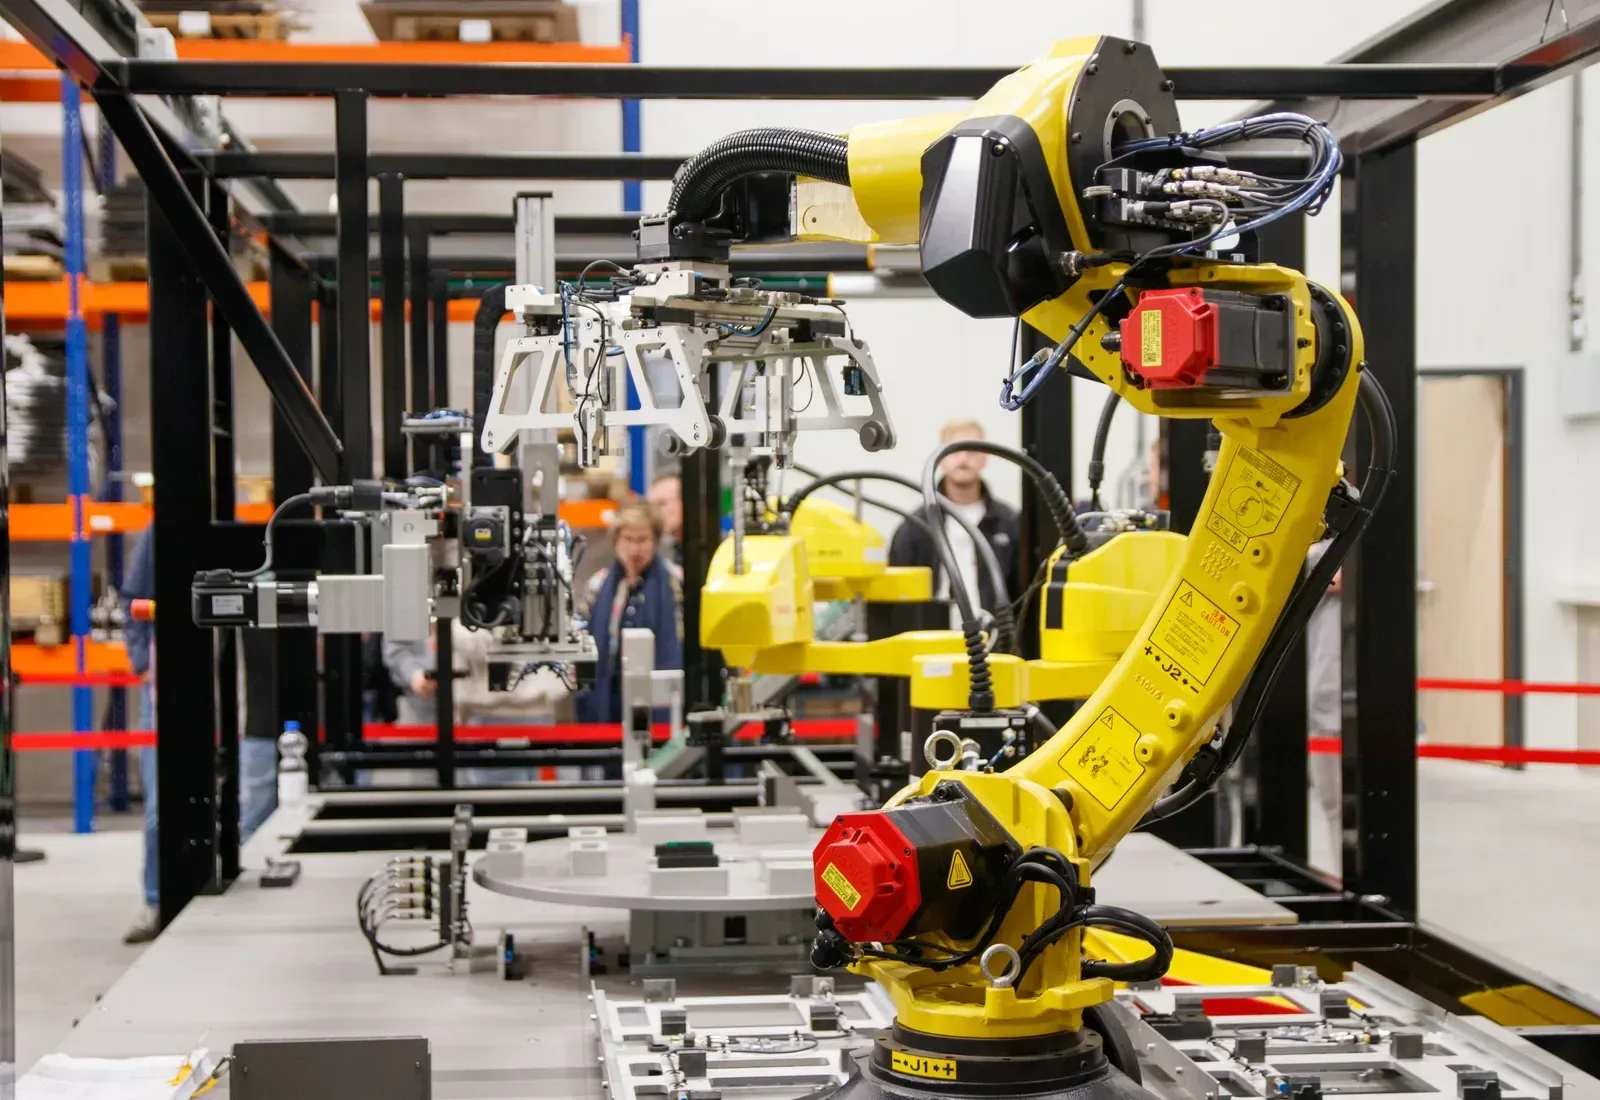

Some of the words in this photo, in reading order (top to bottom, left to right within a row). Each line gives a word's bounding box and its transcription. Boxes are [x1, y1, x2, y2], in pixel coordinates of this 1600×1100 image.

[1200, 610, 1231, 637] CAUTION
[1161, 664, 1182, 681] J2
[910, 1059, 928, 1073] J1
